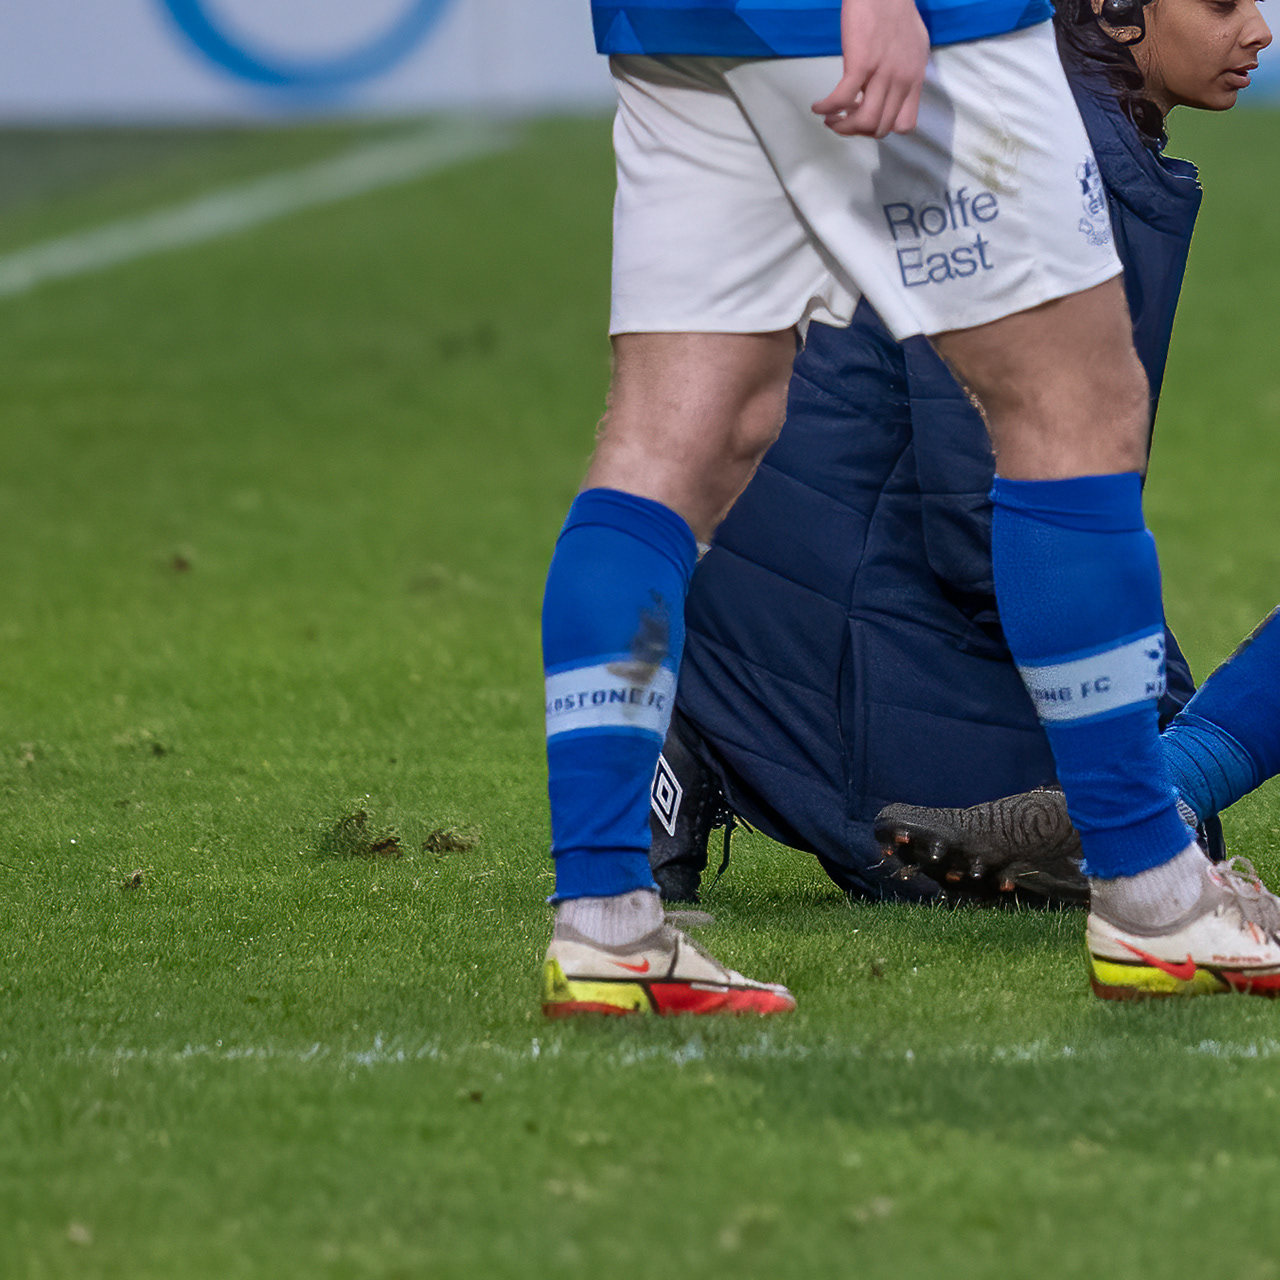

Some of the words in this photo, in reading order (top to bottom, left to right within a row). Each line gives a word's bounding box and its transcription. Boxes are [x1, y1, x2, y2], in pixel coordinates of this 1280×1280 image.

[883, 186, 999, 240] Rolfe
[897, 232, 994, 288] East
[1080, 675, 1111, 699] FC
